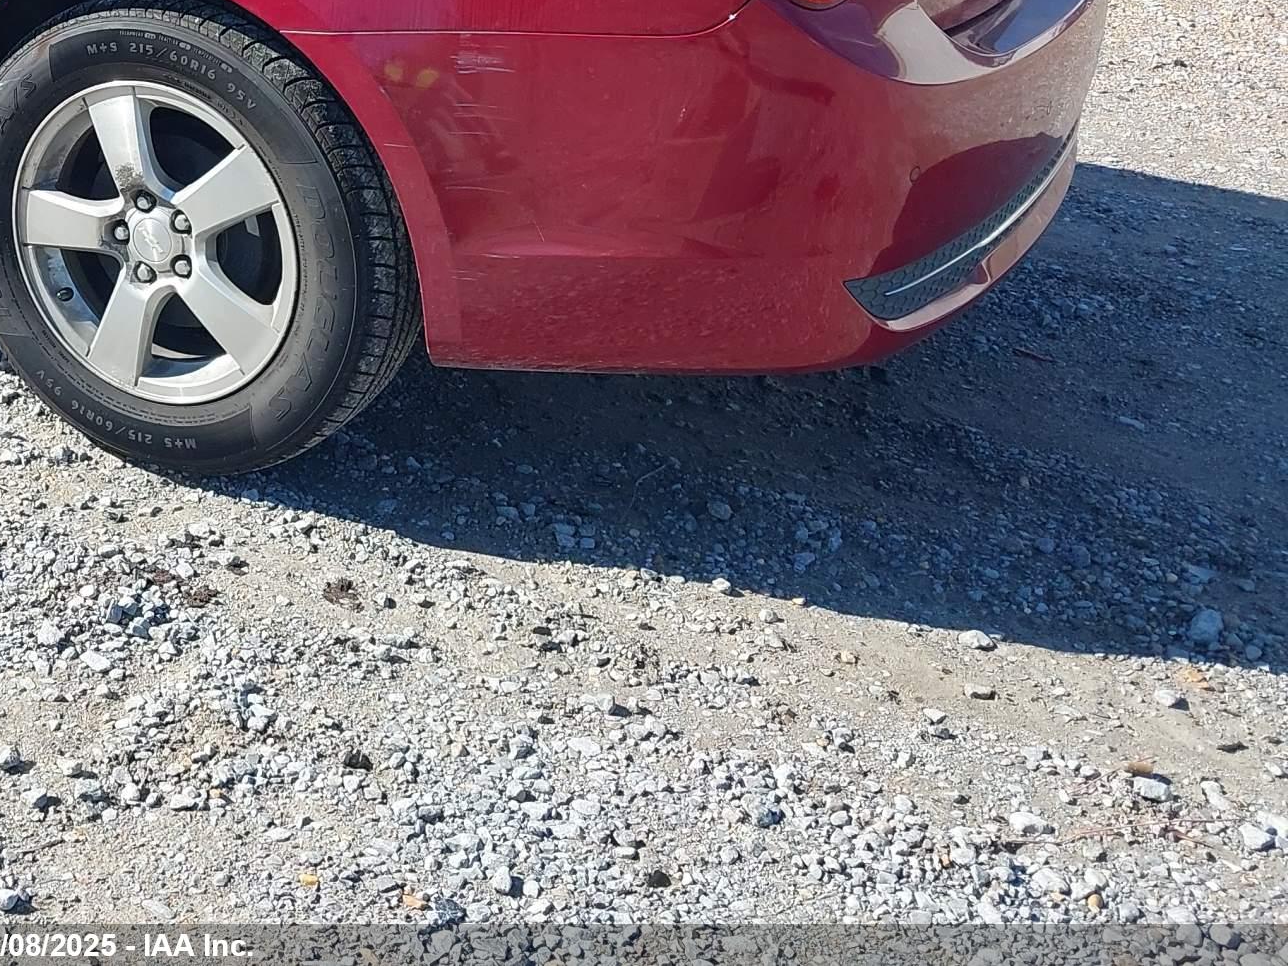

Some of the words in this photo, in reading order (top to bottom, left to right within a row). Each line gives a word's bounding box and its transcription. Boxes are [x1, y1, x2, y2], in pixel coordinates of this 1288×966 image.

[86, 41, 118, 56] M+S
[129, 42, 217, 81] 215/60R16
[226, 82, 257, 111] 95V
[268, 182, 340, 422] DOUGLAS
[35, 369, 64, 397] 95V
[70, 398, 153, 445] 215/60R16
[163, 436, 197, 450] M+S
